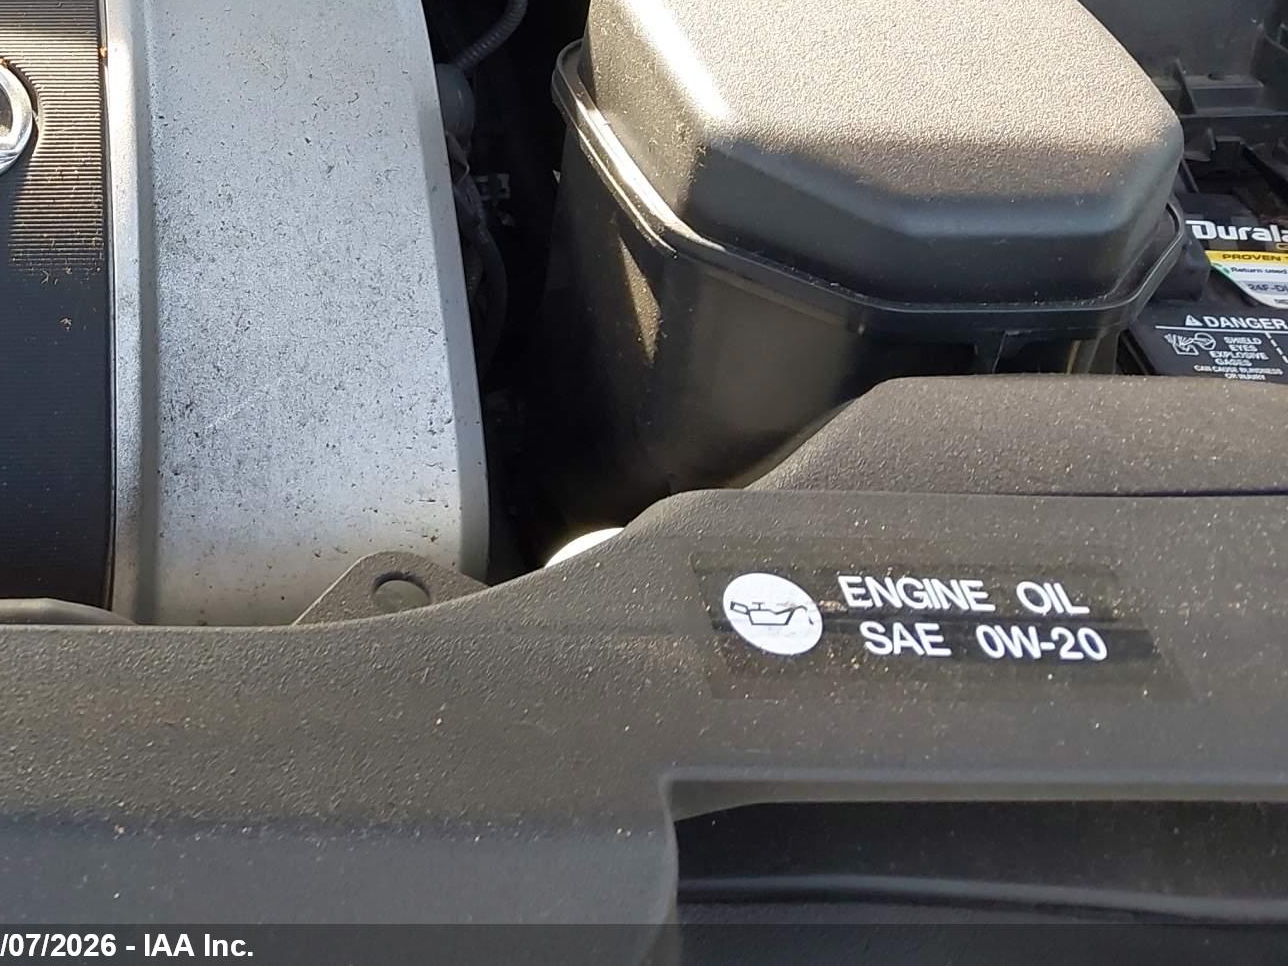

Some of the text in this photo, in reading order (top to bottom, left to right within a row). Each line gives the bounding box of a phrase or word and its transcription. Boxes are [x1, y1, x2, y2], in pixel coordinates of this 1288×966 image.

[1221, 253, 1282, 262] PROVEN
[1202, 316, 1288, 330] DANGER
[1223, 336, 1262, 345] SHIELD
[1228, 344, 1258, 352] EYES
[1209, 350, 1270, 360] EXPLOSIVE
[837, 575, 1090, 616] ENGINE OIL
[859, 621, 1108, 661] SAE 0W-20
